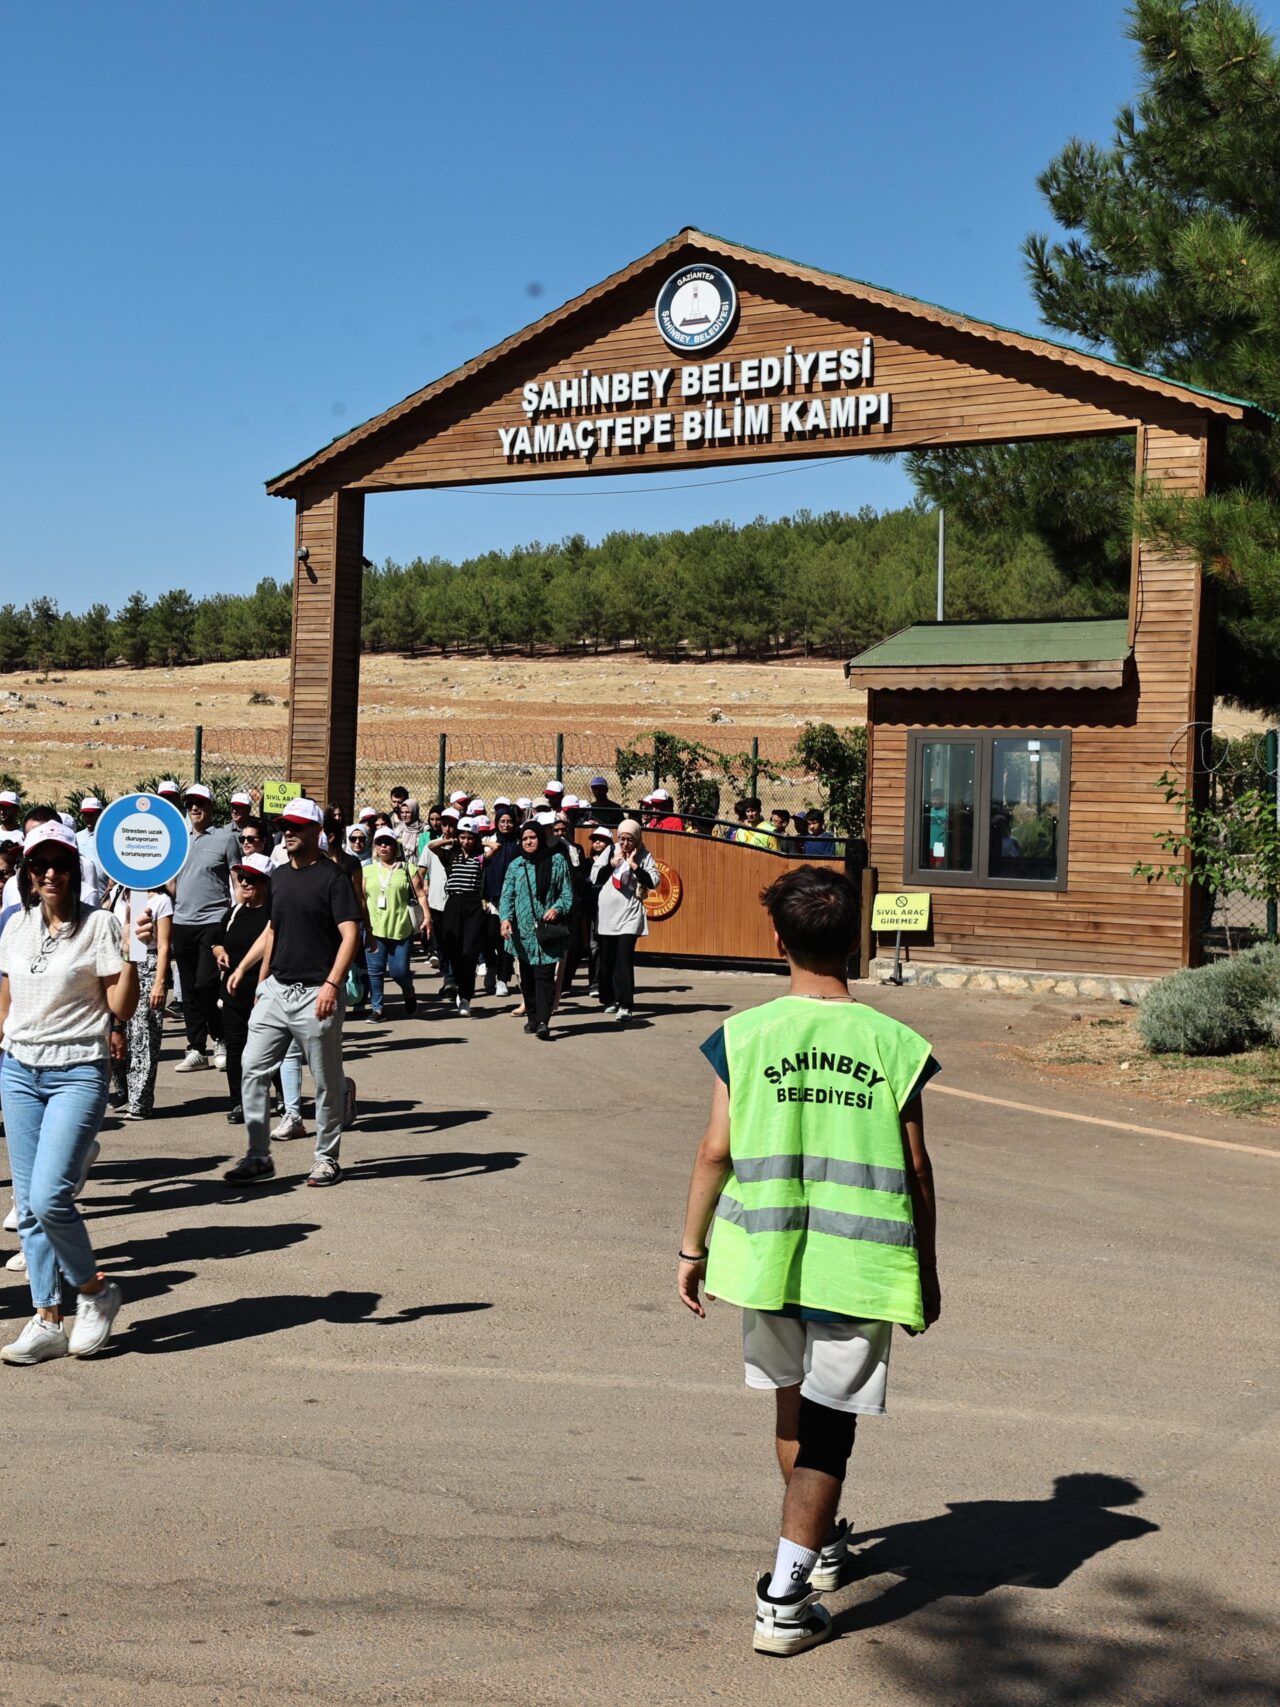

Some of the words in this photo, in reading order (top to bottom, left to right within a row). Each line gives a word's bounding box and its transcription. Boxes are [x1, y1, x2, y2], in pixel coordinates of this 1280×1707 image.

[677, 271, 715, 286] GAZİANTEP
[661, 310, 691, 344] ŞAHİNBEY
[693, 301, 730, 344] BELEDİYESİ
[521, 369, 673, 418] ŞAHİNBEY
[681, 336, 874, 398] BELEDİYESİ
[498, 413, 674, 459] YAMAÇTEPE
[683, 399, 771, 442] BİLİM
[781, 392, 891, 433] KAMPI
[121, 827, 148, 835] Stresten
[121, 851, 162, 859] korunuyorum
[900, 909, 925, 917] ARAÇ
[764, 1047, 886, 1089] ŞAHİNBEY
[777, 1086, 874, 1110] BELEDİYESİ
